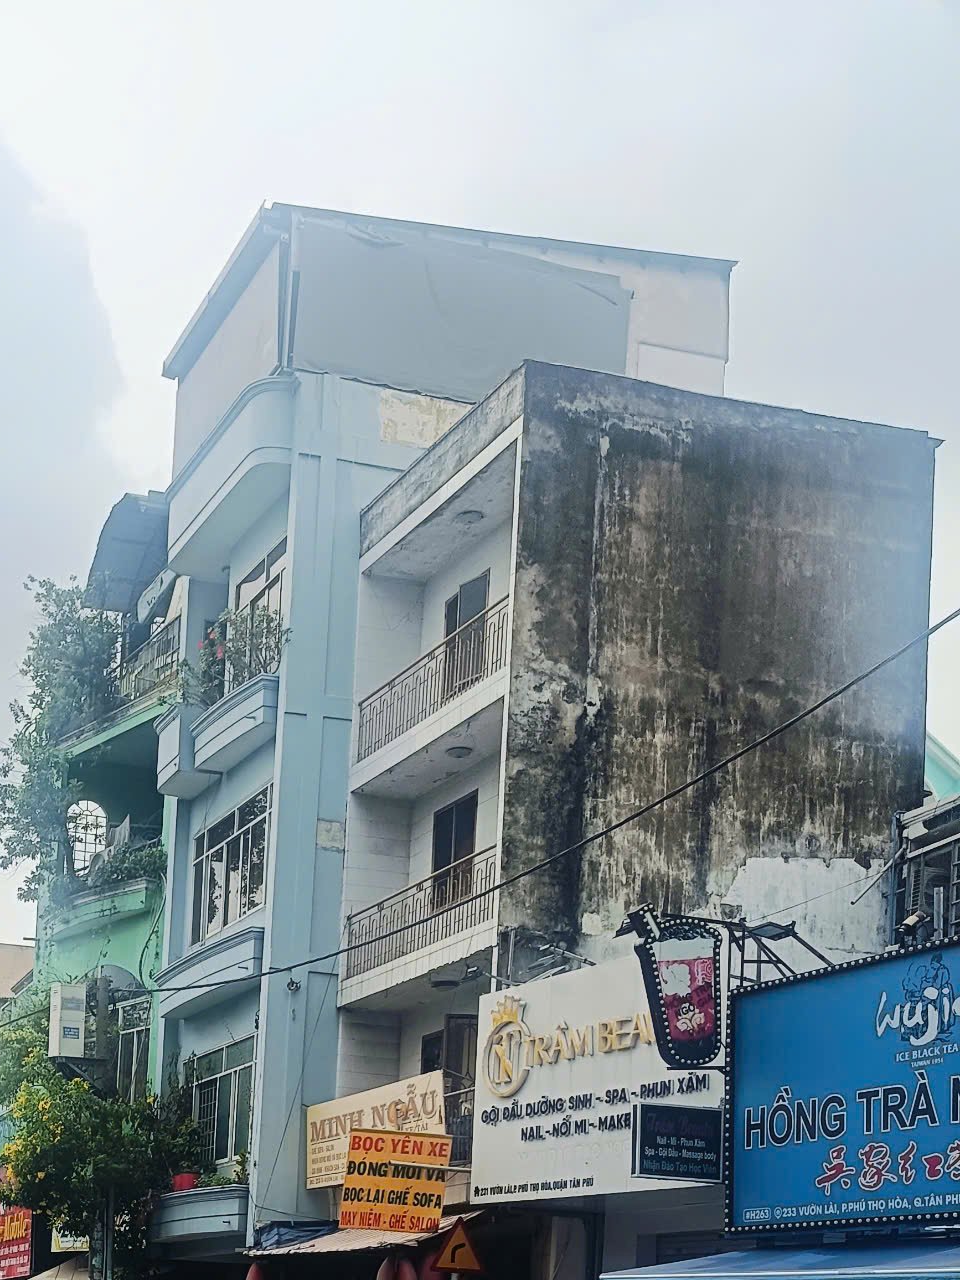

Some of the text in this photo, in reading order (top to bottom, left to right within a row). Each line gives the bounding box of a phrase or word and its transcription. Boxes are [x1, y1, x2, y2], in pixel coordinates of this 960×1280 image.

[598, 1011, 656, 1054] BEA
[896, 1044, 959, 1062] ICE BLACK TEA
[481, 1104, 500, 1127] GỘI
[503, 1099, 524, 1120] ĐẦU
[526, 1096, 566, 1118] DƯỠNG
[568, 1093, 594, 1111] SINH
[605, 1088, 631, 1105] SPA
[640, 1079, 674, 1099] PHUN
[744, 1086, 847, 1150] HỒNG
[856, 1070, 940, 1135] TRÀ
[520, 1125, 545, 1142] NAIL
[657, 1136, 667, 1145] Nail
[352, 1135, 449, 1158] BỌC YÊN XE
[645, 1147, 655, 1156] Spa
[682, 1149, 703, 1161] Massage
[347, 1157, 389, 1177] ĐÓNG
[569, 1178, 581, 1189] TÂN
[582, 1176, 594, 1188] PHÚ
[343, 1185, 442, 1209] BỌC LẠI GHẾ SOFA
[781, 1207, 797, 1217] 233
[798, 1204, 823, 1217] VƯỜN
[842, 1198, 866, 1213] P.PHÚ
[868, 1200, 886, 1213] THỌ
[888, 1195, 912, 1210] HÒA,
[913, 1194, 944, 1208] Q.TÂN
[341, 1210, 357, 1226] MAY
[389, 1209, 409, 1229] GHẾ
[409, 1215, 440, 1233] SALON
